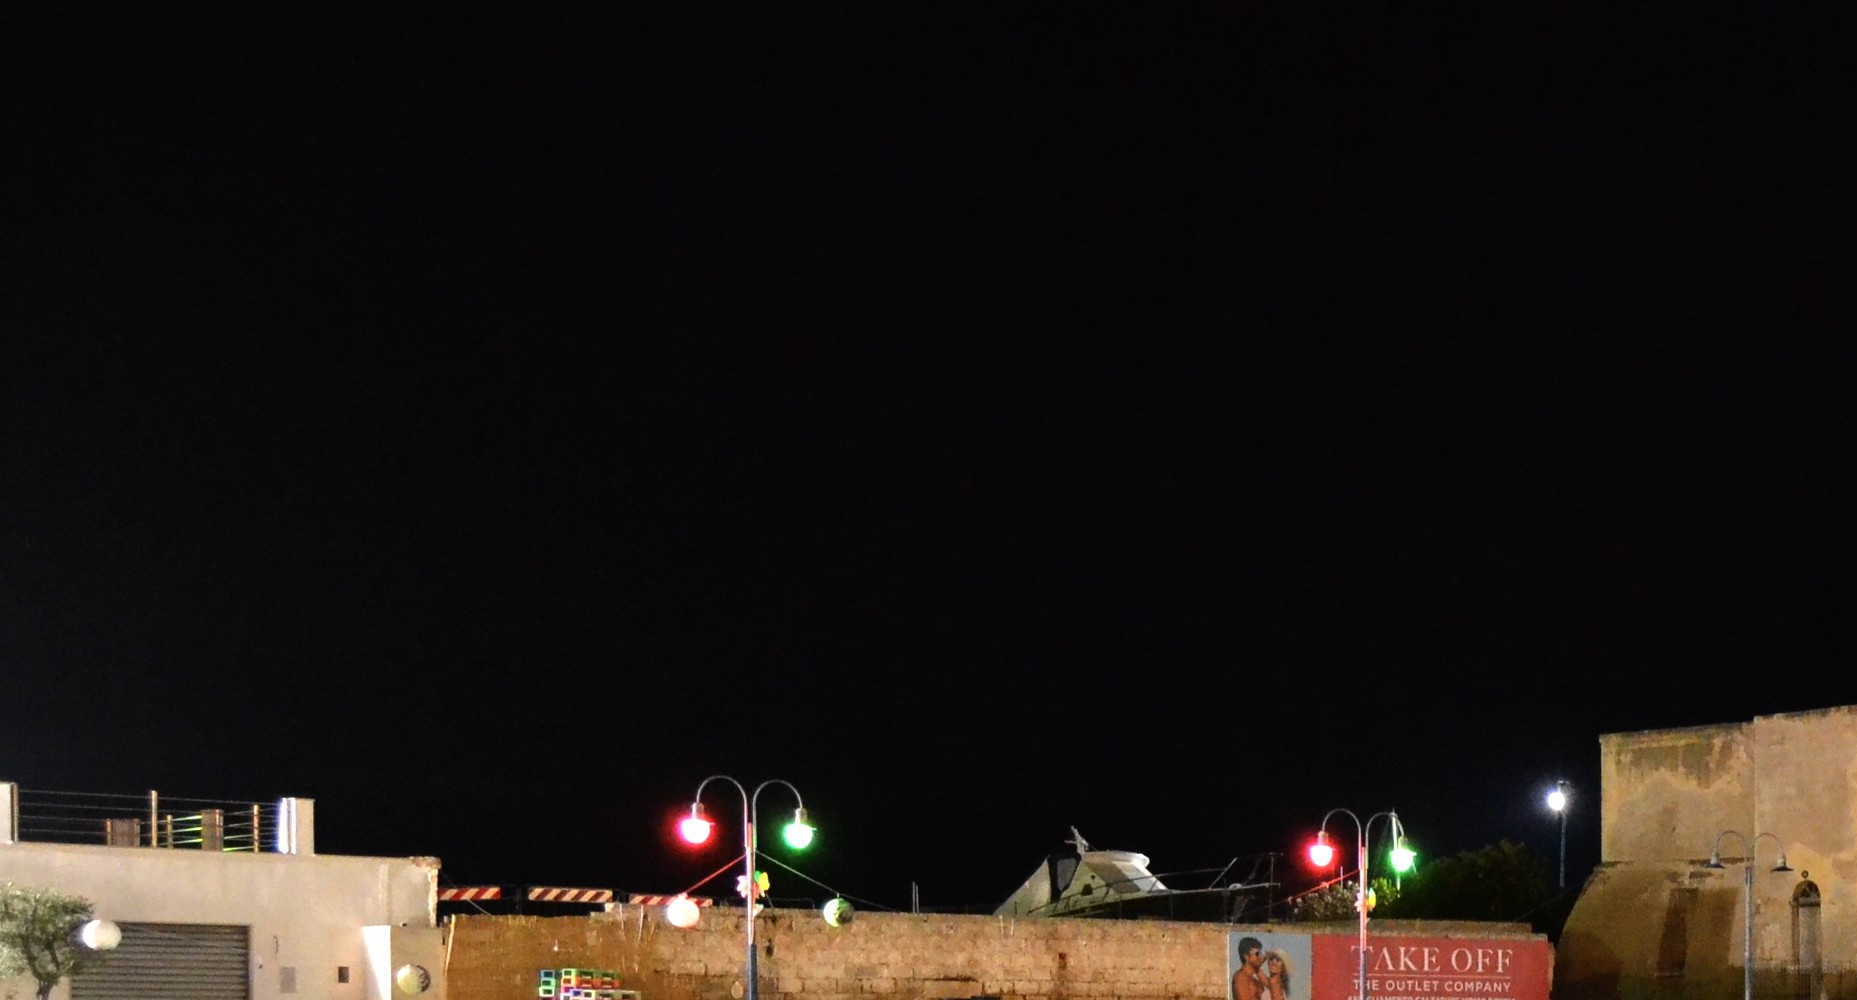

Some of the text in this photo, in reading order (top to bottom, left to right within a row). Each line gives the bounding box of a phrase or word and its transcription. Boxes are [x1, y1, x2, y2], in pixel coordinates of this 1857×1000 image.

[1351, 945, 1513, 973] TAKE OFF
[1385, 980, 1439, 992] OUTLET
[1444, 981, 1511, 993] COMPANY
